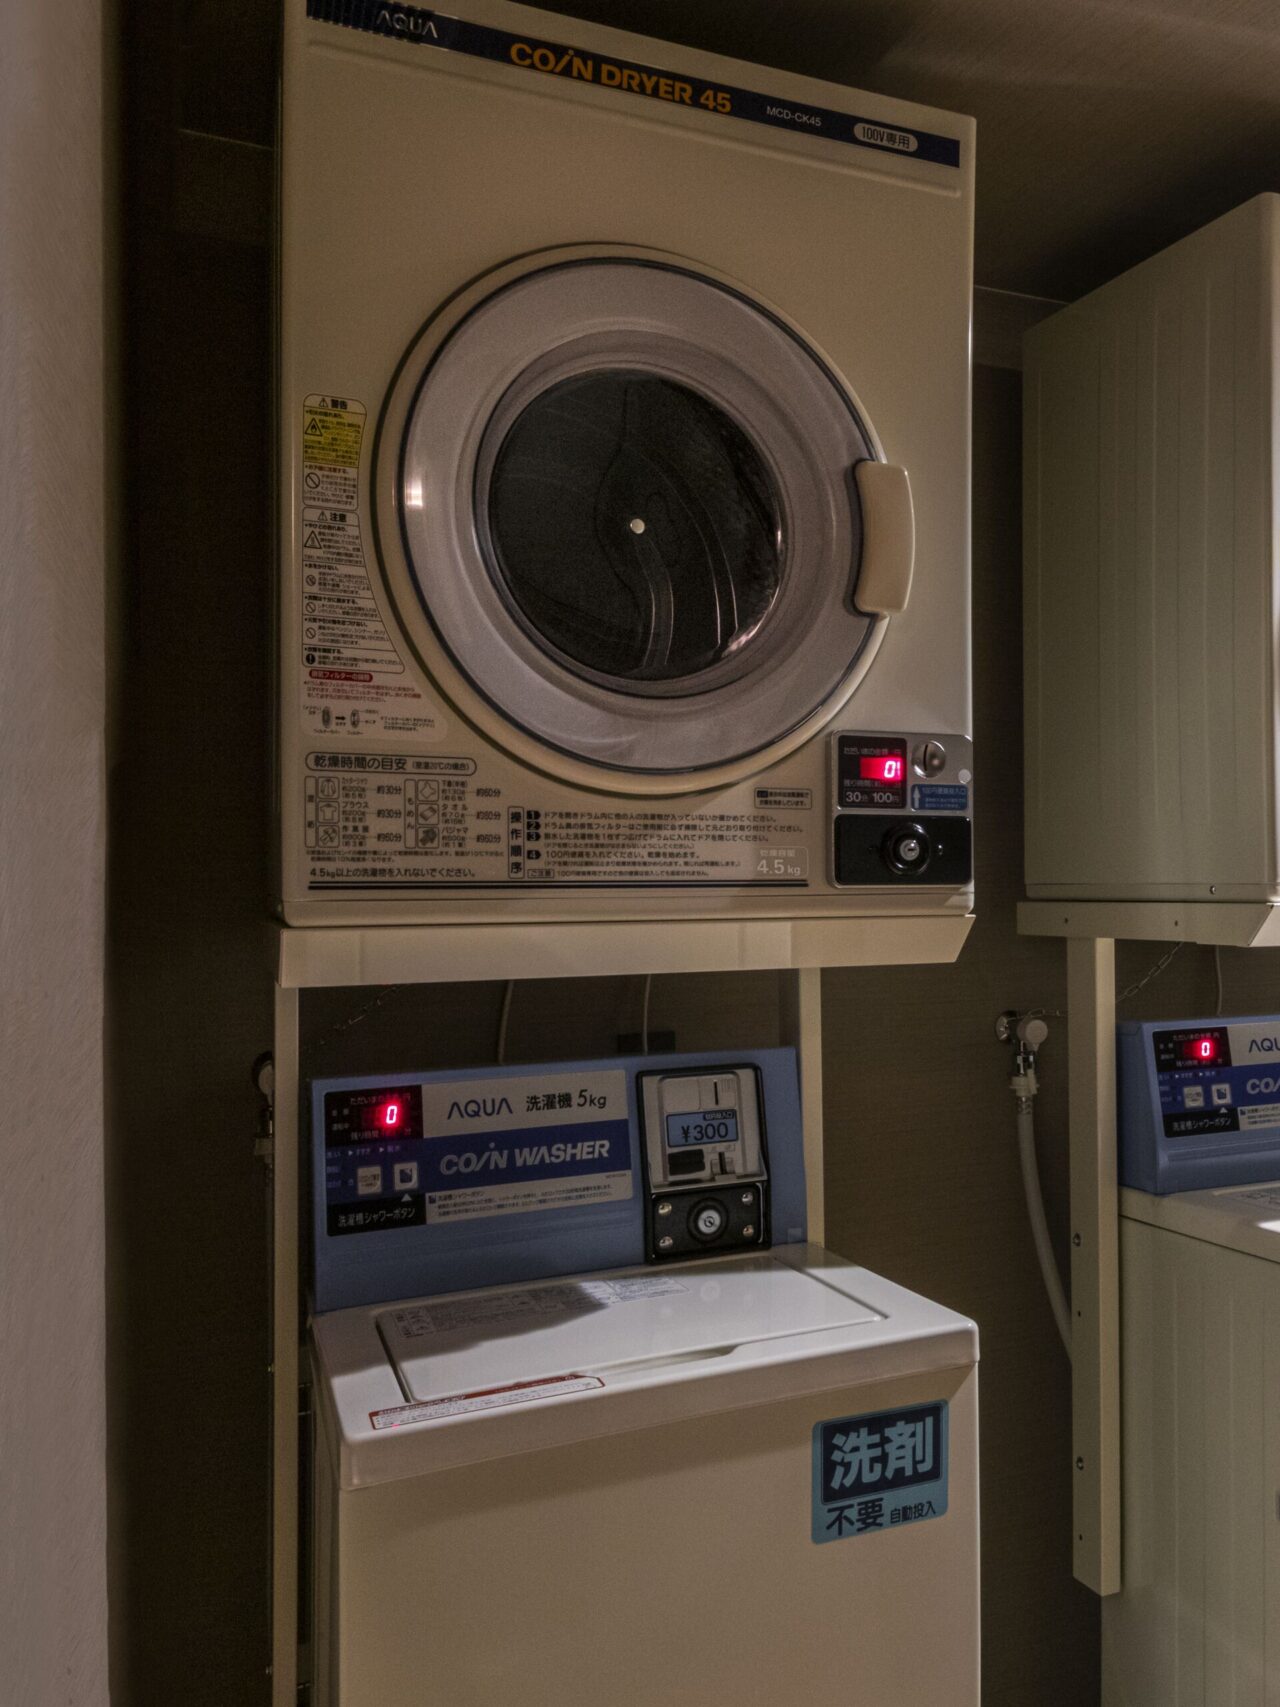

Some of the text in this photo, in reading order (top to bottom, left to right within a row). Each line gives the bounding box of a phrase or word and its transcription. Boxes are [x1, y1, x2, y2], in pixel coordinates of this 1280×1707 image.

[376, 10, 438, 38] AQUA
[601, 63, 693, 105] DRYER
[700, 90, 732, 114] 45
[766, 105, 822, 127] MCD-CK45
[861, 125, 910, 149] 100V専用
[330, 512, 347, 522] 注意
[314, 755, 408, 770] 乾燥時間の目安
[1200, 1041, 1210, 1057] 0
[447, 1098, 514, 1121] AQUA
[526, 1089, 607, 1112] 洗濯機 5kg
[386, 1105, 398, 1124] 0
[681, 1122, 729, 1143] ¥300
[514, 1139, 611, 1167] WASHER
[830, 1416, 934, 1490] 洗剤
[826, 1497, 937, 1536] 不要 自動投入
